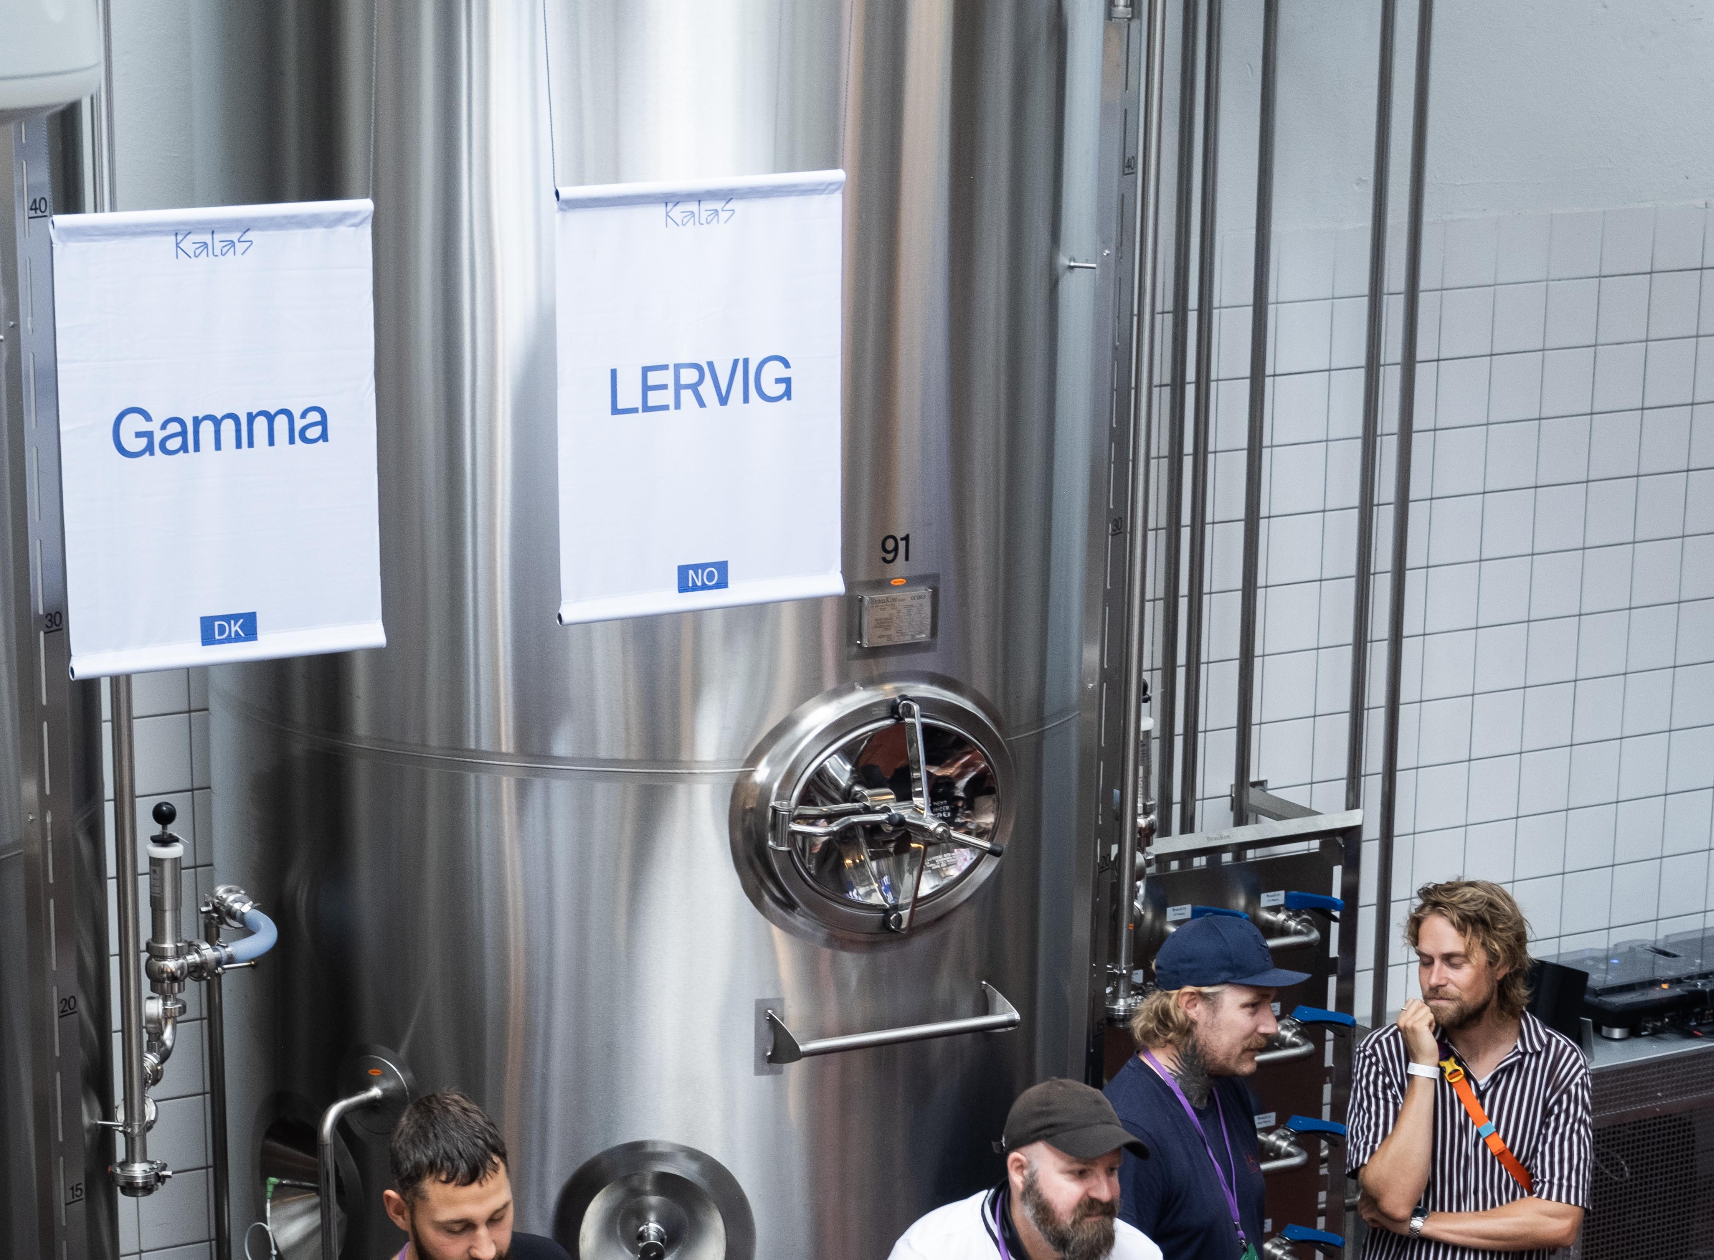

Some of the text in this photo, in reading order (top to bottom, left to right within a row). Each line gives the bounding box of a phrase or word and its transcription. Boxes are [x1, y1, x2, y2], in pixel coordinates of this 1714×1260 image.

[29, 197, 47, 214] 40
[610, 354, 793, 416] LERVIG
[112, 405, 330, 459] Gamma
[881, 533, 910, 564] 91
[688, 567, 719, 588] NO
[45, 611, 62, 629] 30
[214, 618, 245, 640] DK
[60, 995, 77, 1013] 20
[69, 1182, 84, 1199] 15
